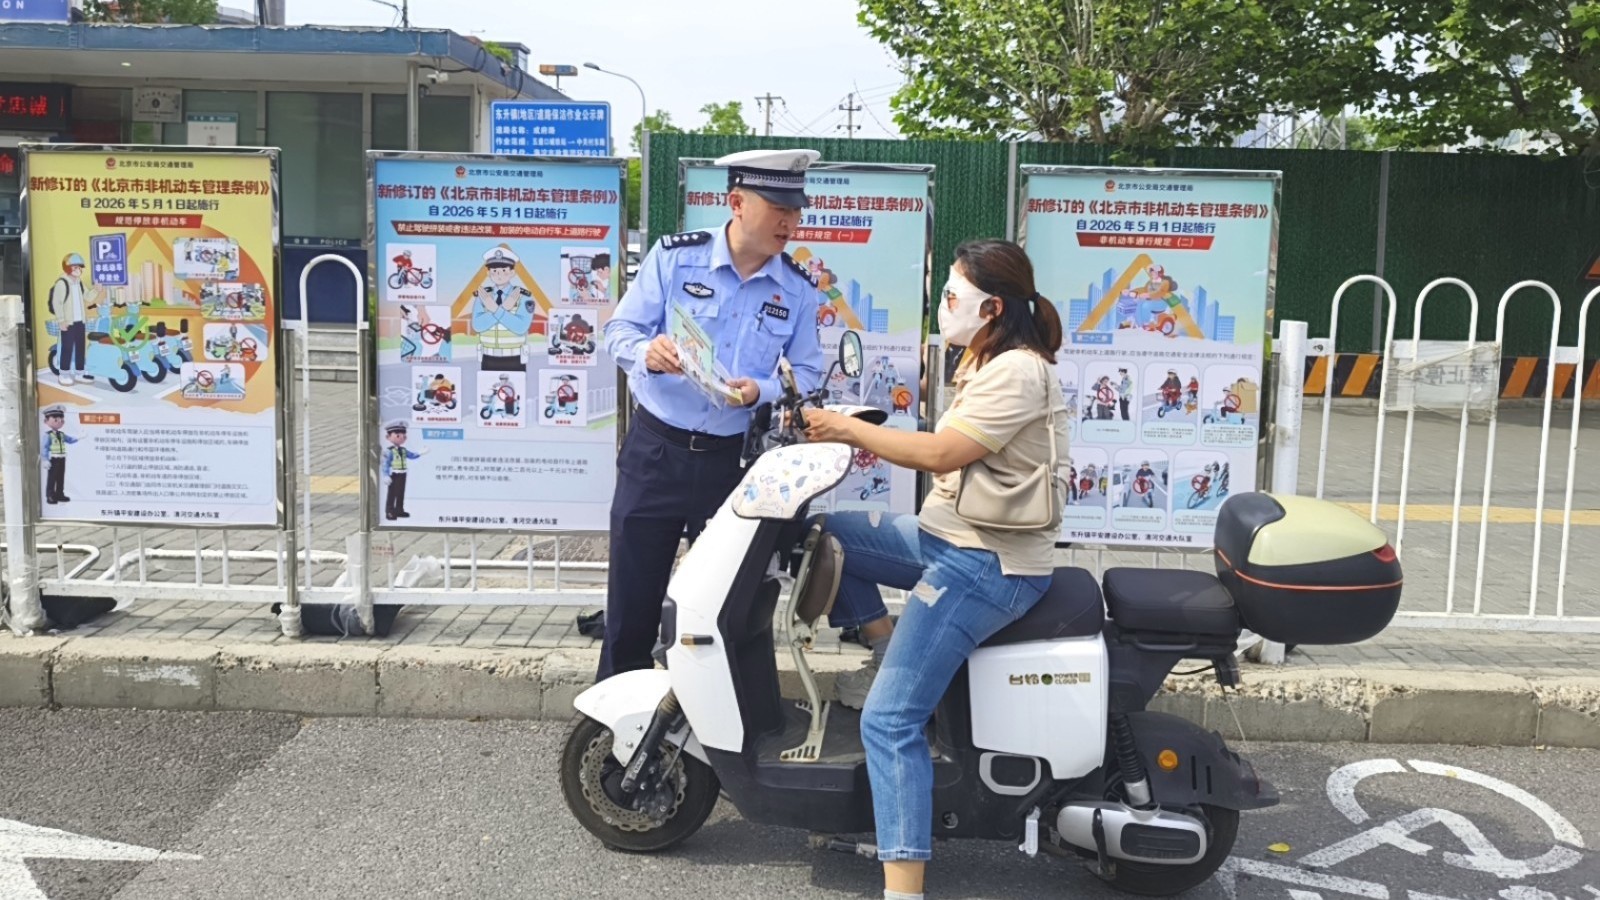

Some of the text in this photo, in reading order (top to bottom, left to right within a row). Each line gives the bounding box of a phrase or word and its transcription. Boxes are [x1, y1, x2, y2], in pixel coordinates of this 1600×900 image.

[119, 160, 194, 169] 北京市公安局交通管理局
[468, 169, 543, 178] 北京市公安局交通管理局
[30, 176, 270, 196] 新修订的《北京市非机动车管理条例》
[1118, 183, 1193, 192] 北京市公安局交通管理局
[377, 184, 618, 204] 新修订的《北京市非机动车管理条例》
[1027, 198, 1269, 219] 新修订的《北京市非机动车管理条例》
[114, 216, 188, 226] 规范停放非机动车
[320, 238, 347, 246] POLICE
[99, 241, 111, 260] P
